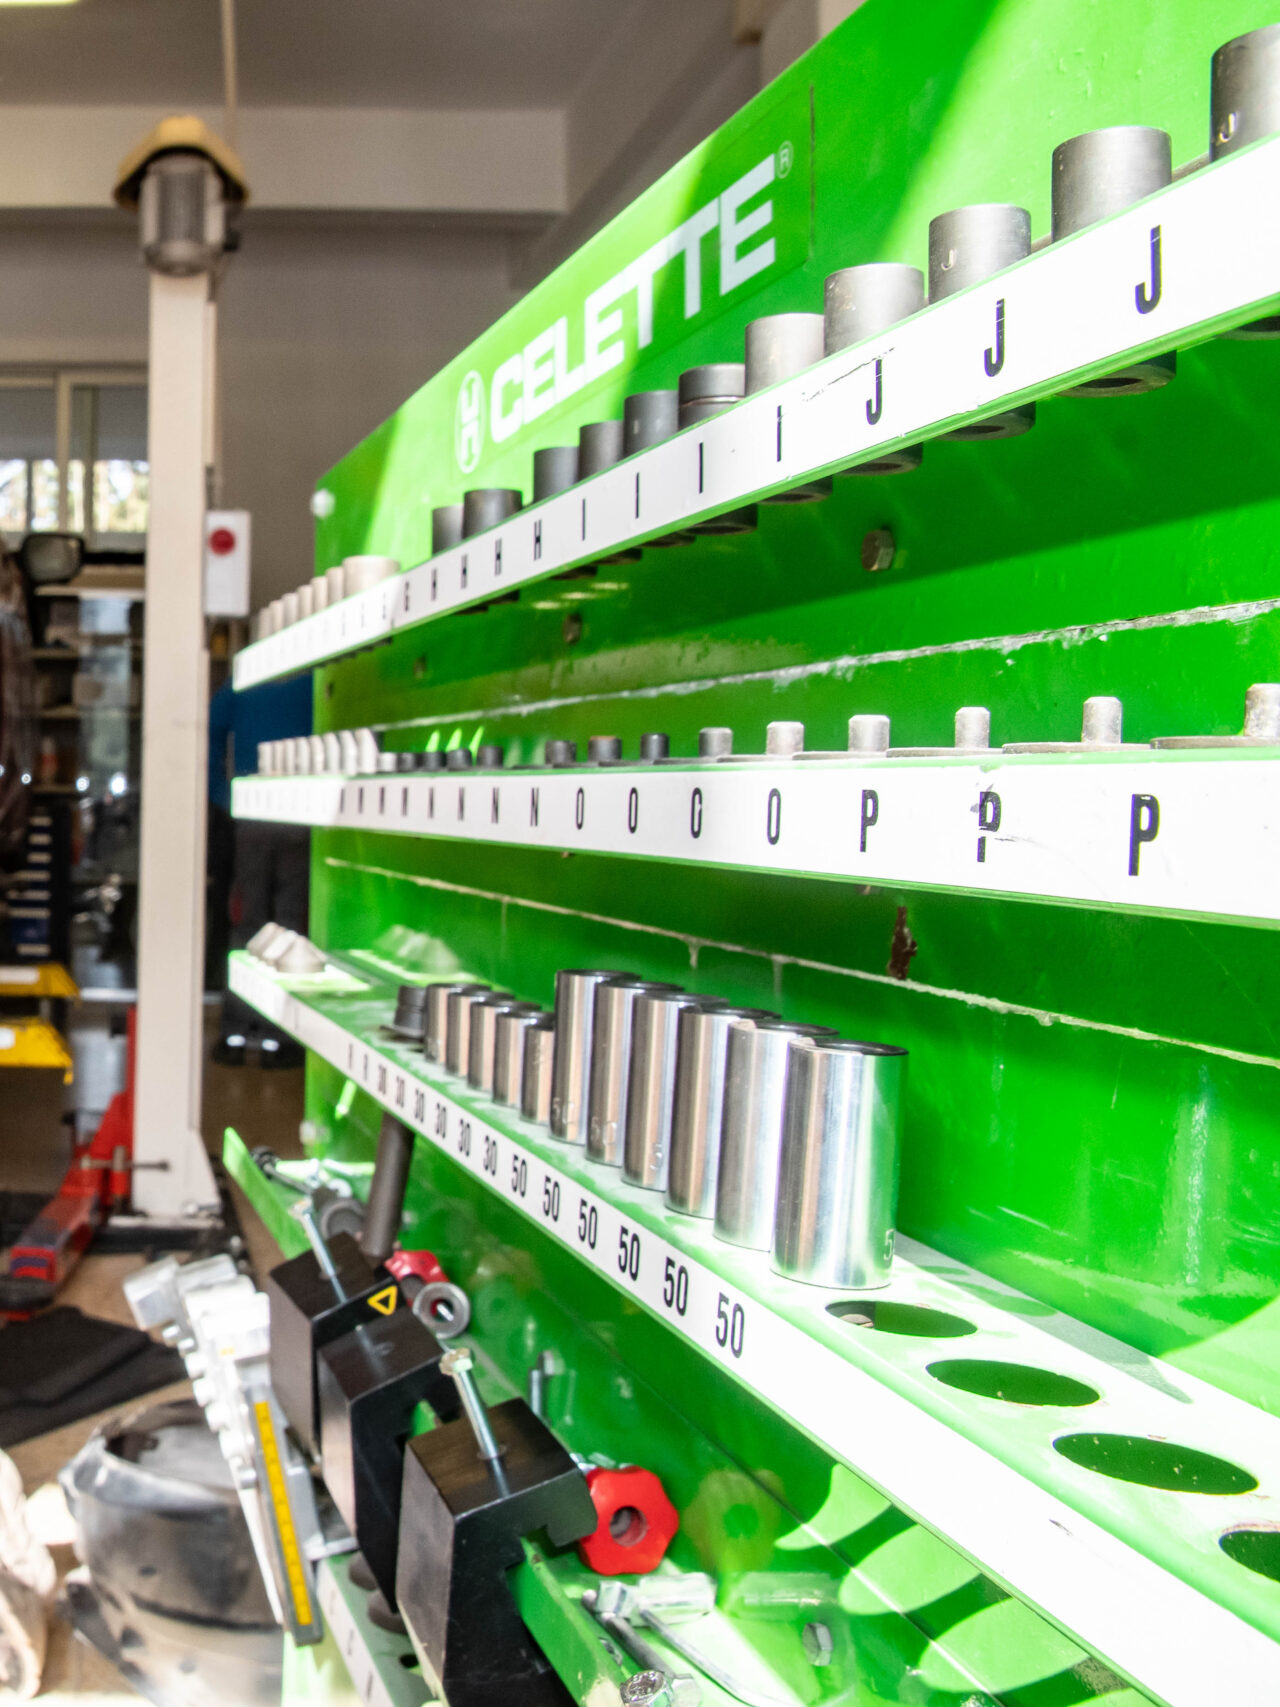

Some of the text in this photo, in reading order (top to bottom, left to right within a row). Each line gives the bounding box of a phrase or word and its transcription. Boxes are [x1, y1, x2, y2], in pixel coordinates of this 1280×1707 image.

[490, 153, 776, 444] CELETTE
[495, 538, 502, 576] H
[534, 519, 542, 561] H
[866, 359, 883, 426] J
[983, 298, 1005, 378] J
[1135, 224, 1162, 315] J
[491, 787, 500, 824] N
[530, 787, 540, 827] N
[860, 789, 880, 853] P
[976, 790, 1003, 864] P
[1128, 793, 1161, 877] P
[435, 1102, 447, 1139] 30
[458, 1118, 471, 1157] 30
[483, 1135, 498, 1176] 30
[511, 1153, 528, 1198] 50
[543, 1175, 561, 1222] 50
[578, 1199, 598, 1250] 50
[618, 1225, 640, 1282] 50
[663, 1256, 689, 1317] 50
[715, 1291, 745, 1359] 50
